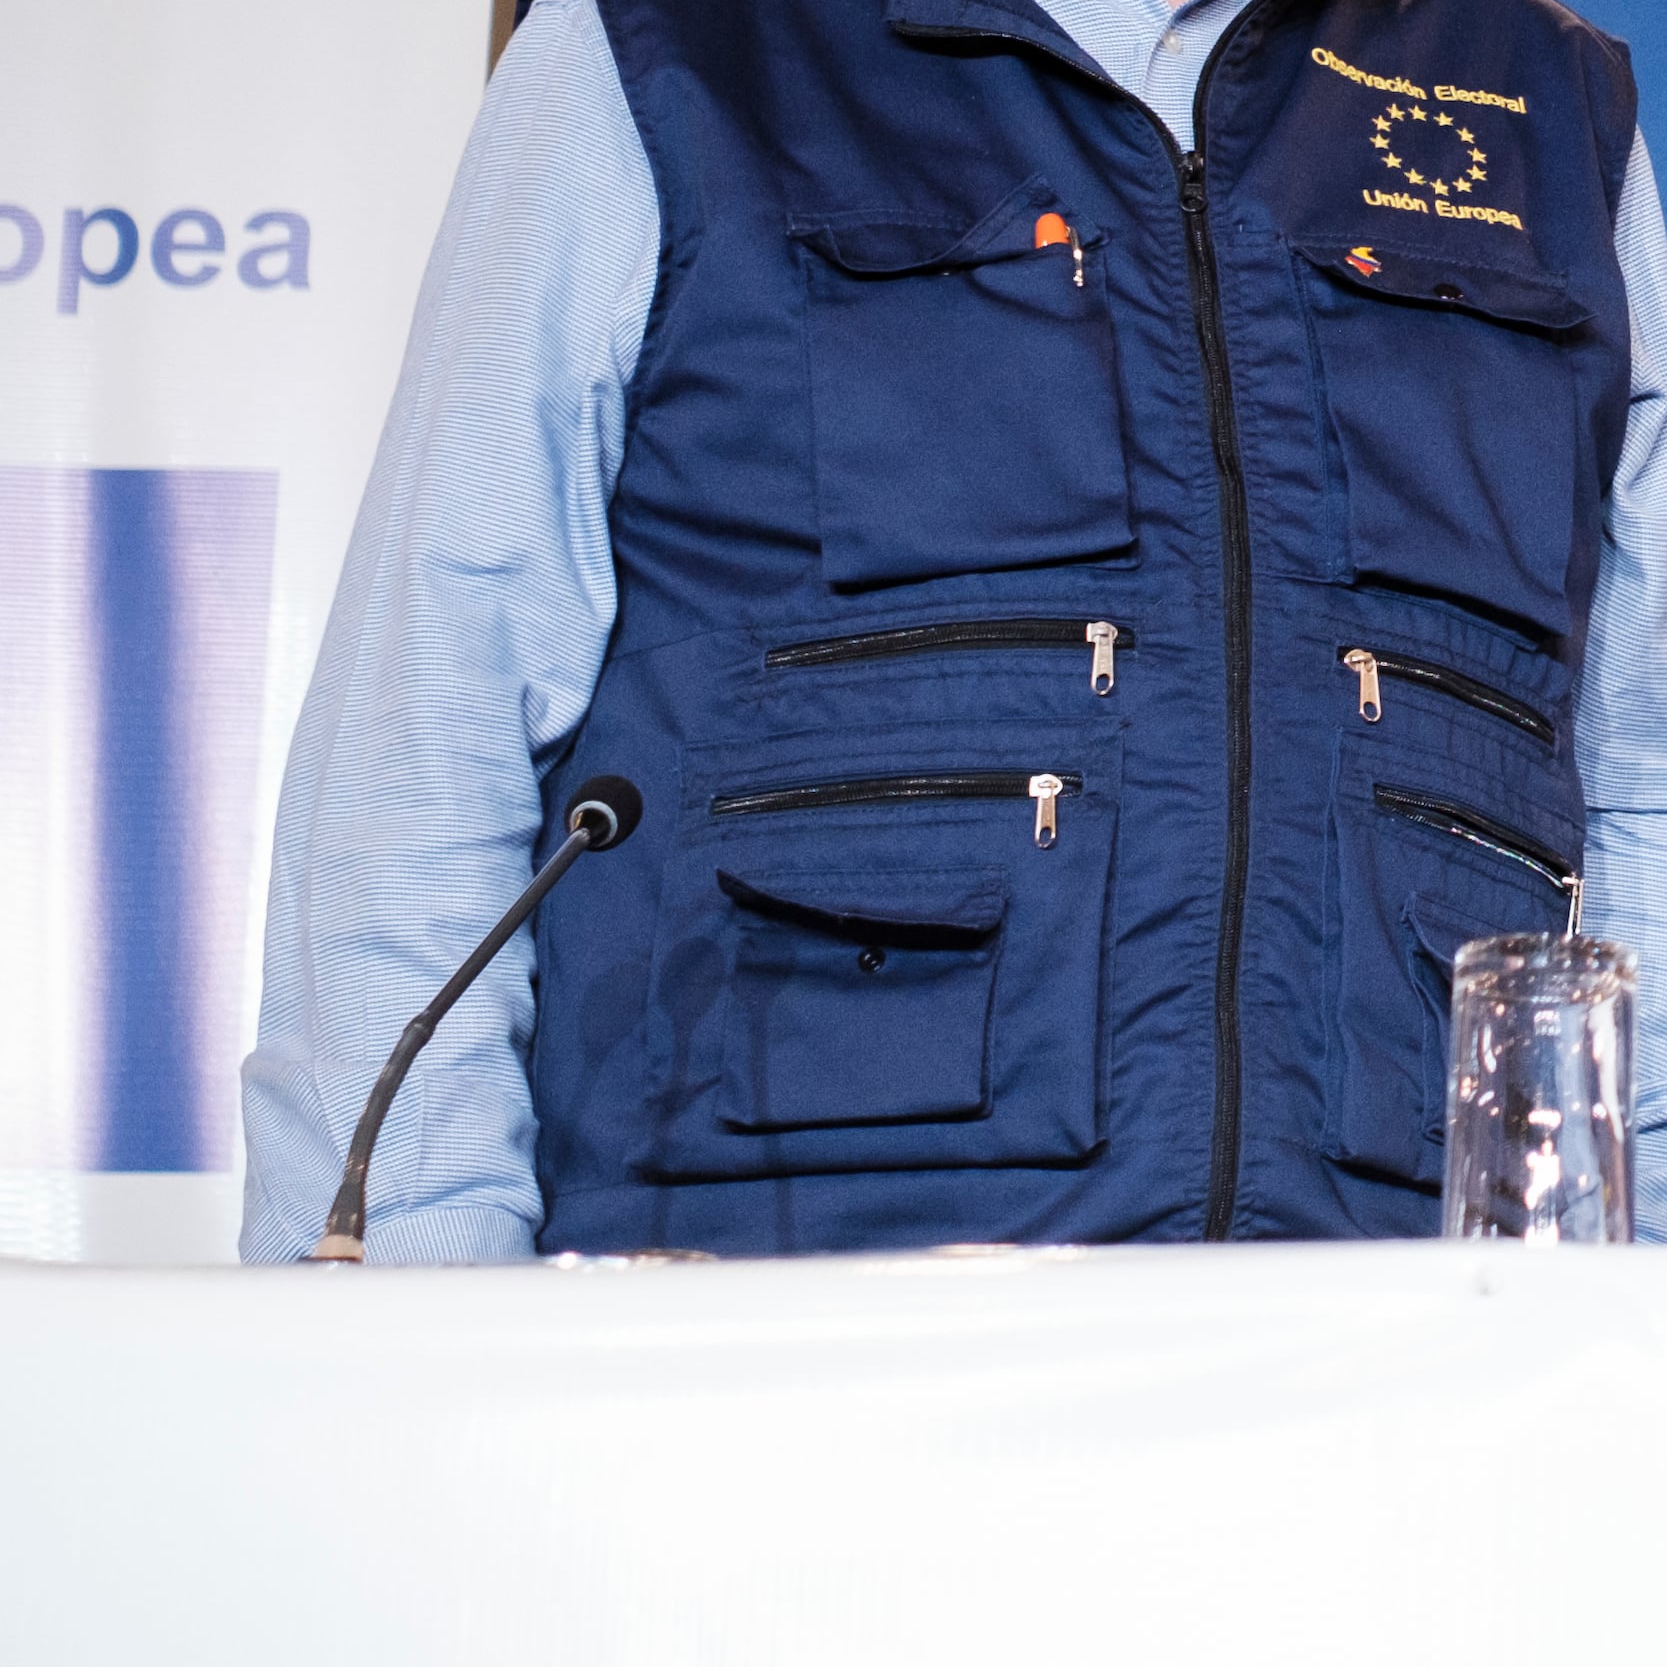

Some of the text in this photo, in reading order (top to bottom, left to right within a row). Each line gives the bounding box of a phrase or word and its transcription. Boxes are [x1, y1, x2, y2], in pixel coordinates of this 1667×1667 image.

[1311, 47, 1527, 114] Observación Electoral
[1363, 189, 1523, 230] Unión Europea
